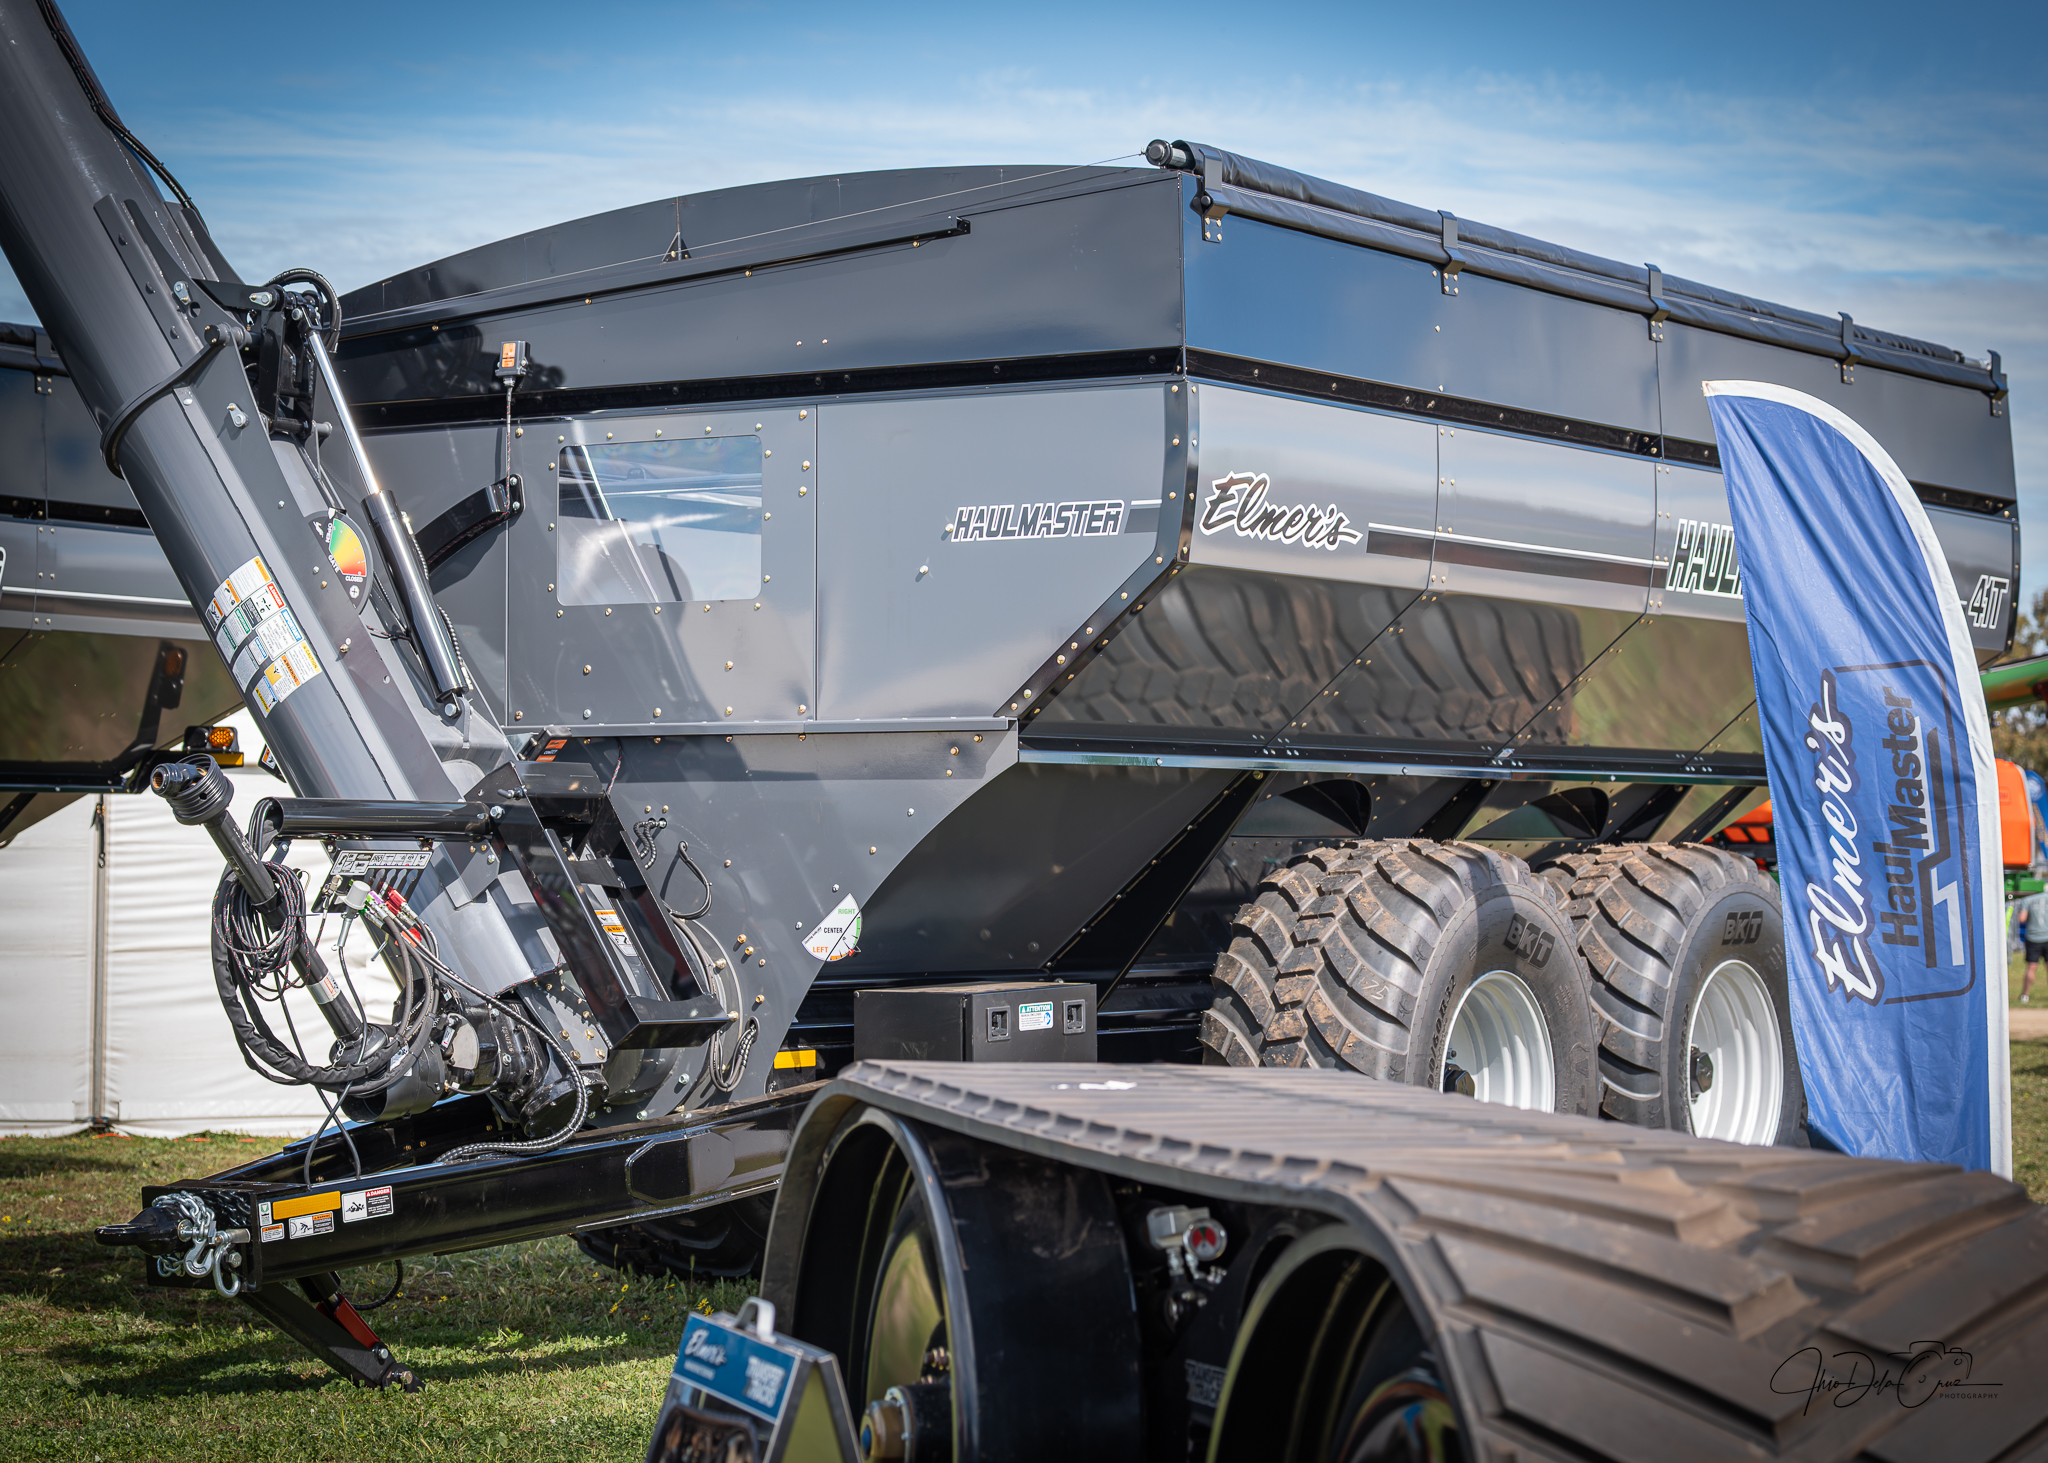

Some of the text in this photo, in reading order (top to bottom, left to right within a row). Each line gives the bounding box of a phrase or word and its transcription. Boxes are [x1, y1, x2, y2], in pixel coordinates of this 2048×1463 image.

[951, 499, 1125, 542] HAULMASTER
[1200, 470, 1363, 551] Elmer's
[328, 555, 340, 573] GATE
[1666, 518, 1743, 599] HAUL
[282, 611, 302, 641] IMPORTANT
[1968, 574, 2009, 629] 41T
[305, 649, 318, 669] CAUTION
[1805, 668, 1885, 1007] Elmer's
[1873, 686, 1929, 947] HaulMaster
[1503, 913, 1555, 969] BKT
[1722, 911, 1763, 945] BKT
[1427, 974, 1456, 1088] 00/60R32
[370, 1188, 390, 1196] DANGER
